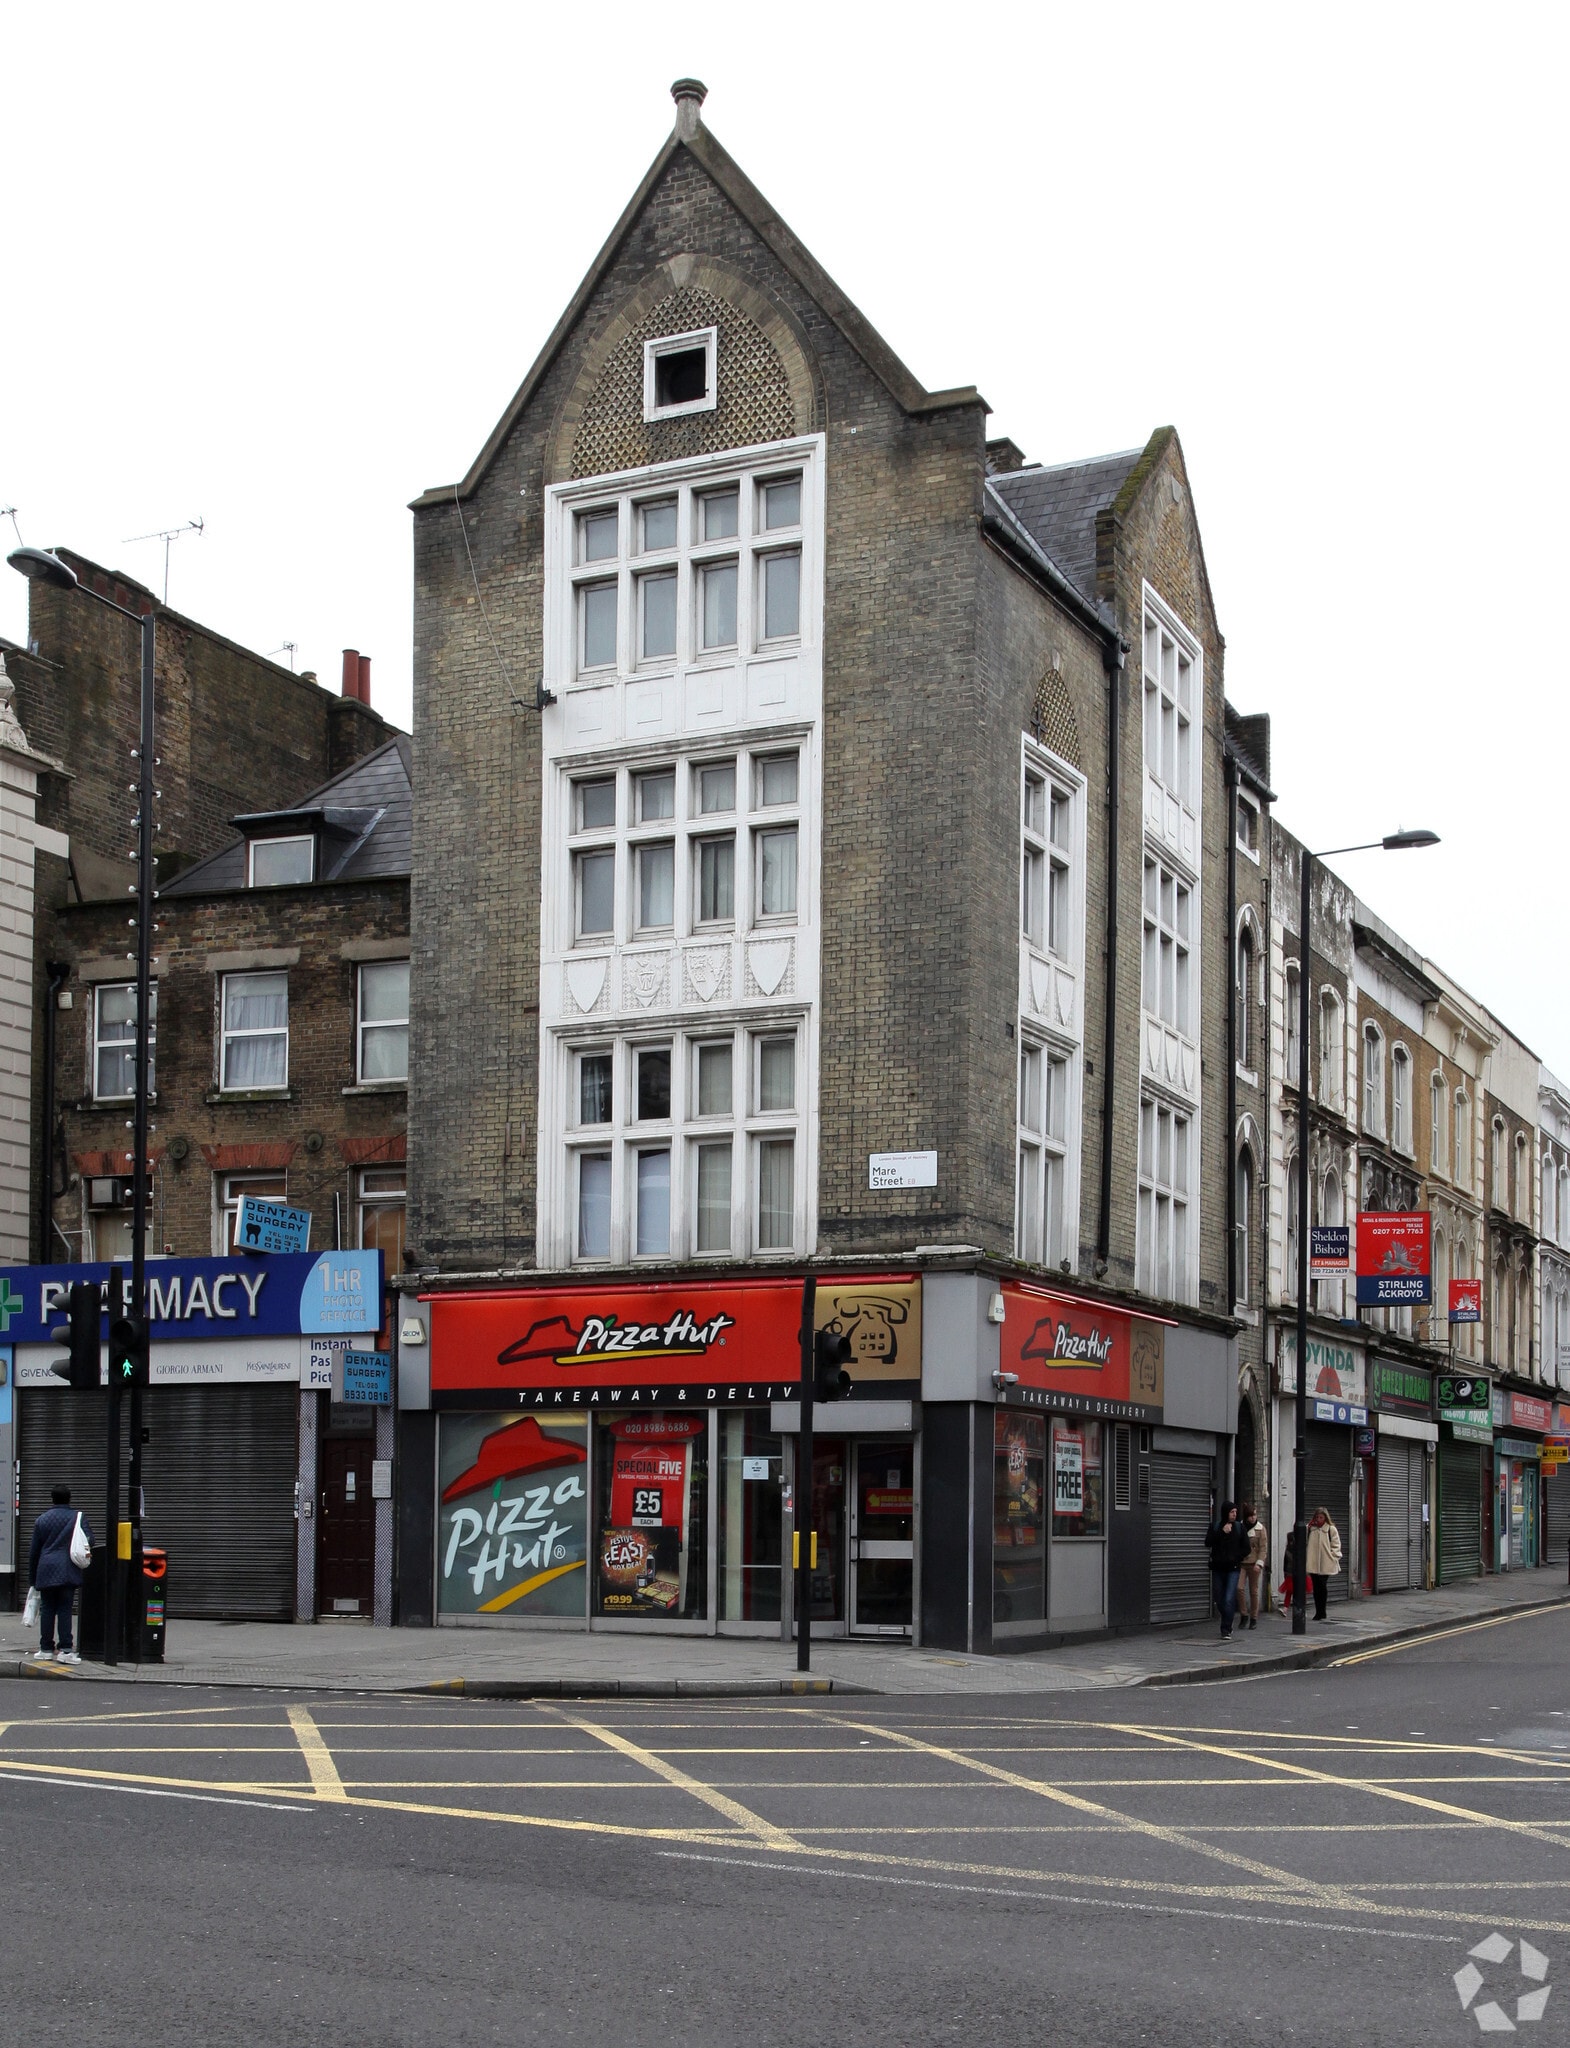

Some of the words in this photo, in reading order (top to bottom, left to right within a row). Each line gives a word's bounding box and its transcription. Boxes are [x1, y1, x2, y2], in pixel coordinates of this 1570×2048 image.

[872, 1167, 896, 1176] Mare
[872, 1176, 903, 1186] Street
[246, 1201, 306, 1223] DENTAL
[248, 1212, 302, 1232] SURGERY
[265, 1236, 300, 1248] 8533
[1312, 1231, 1348, 1241] Sheldon
[1315, 1244, 1345, 1256] Bishop
[1378, 1290, 1423, 1298] ACKROYD
[324, 1295, 363, 1307] PHOTO
[320, 1309, 366, 1322] SERVICE
[576, 1314, 659, 1355] Pizza
[664, 1312, 734, 1345] Hut
[311, 1340, 352, 1350] Instant
[1054, 1324, 1086, 1359] Pizza
[1087, 1329, 1112, 1360] Hut
[346, 1356, 388, 1366] DENTAL
[156, 1365, 189, 1374] GIORGIO
[191, 1364, 223, 1374] ARMANI
[347, 1368, 386, 1378] SURGERY
[1382, 1367, 1403, 1396] GREEN
[1405, 1374, 1430, 1402] DRAGON
[345, 1390, 365, 1399] 8533
[368, 1392, 388, 1401] 0816
[518, 1389, 659, 1403] TAKEAWAY
[678, 1389, 686, 1400] &
[1022, 1391, 1079, 1409] TAKEAWAY
[1085, 1401, 1089, 1411] &
[1097, 1402, 1146, 1418] DELIVERY
[626, 1424, 641, 1433] 020
[644, 1423, 665, 1433] 8986
[1056, 1470, 1081, 1499] FREE
[635, 1491, 660, 1514] £5
[444, 1476, 586, 1578] Pizza
[610, 1535, 634, 1544] FESTIVE
[468, 1521, 572, 1595] Hut
[604, 1542, 644, 1568] FEAST
[604, 1595, 632, 1604] £19.99
